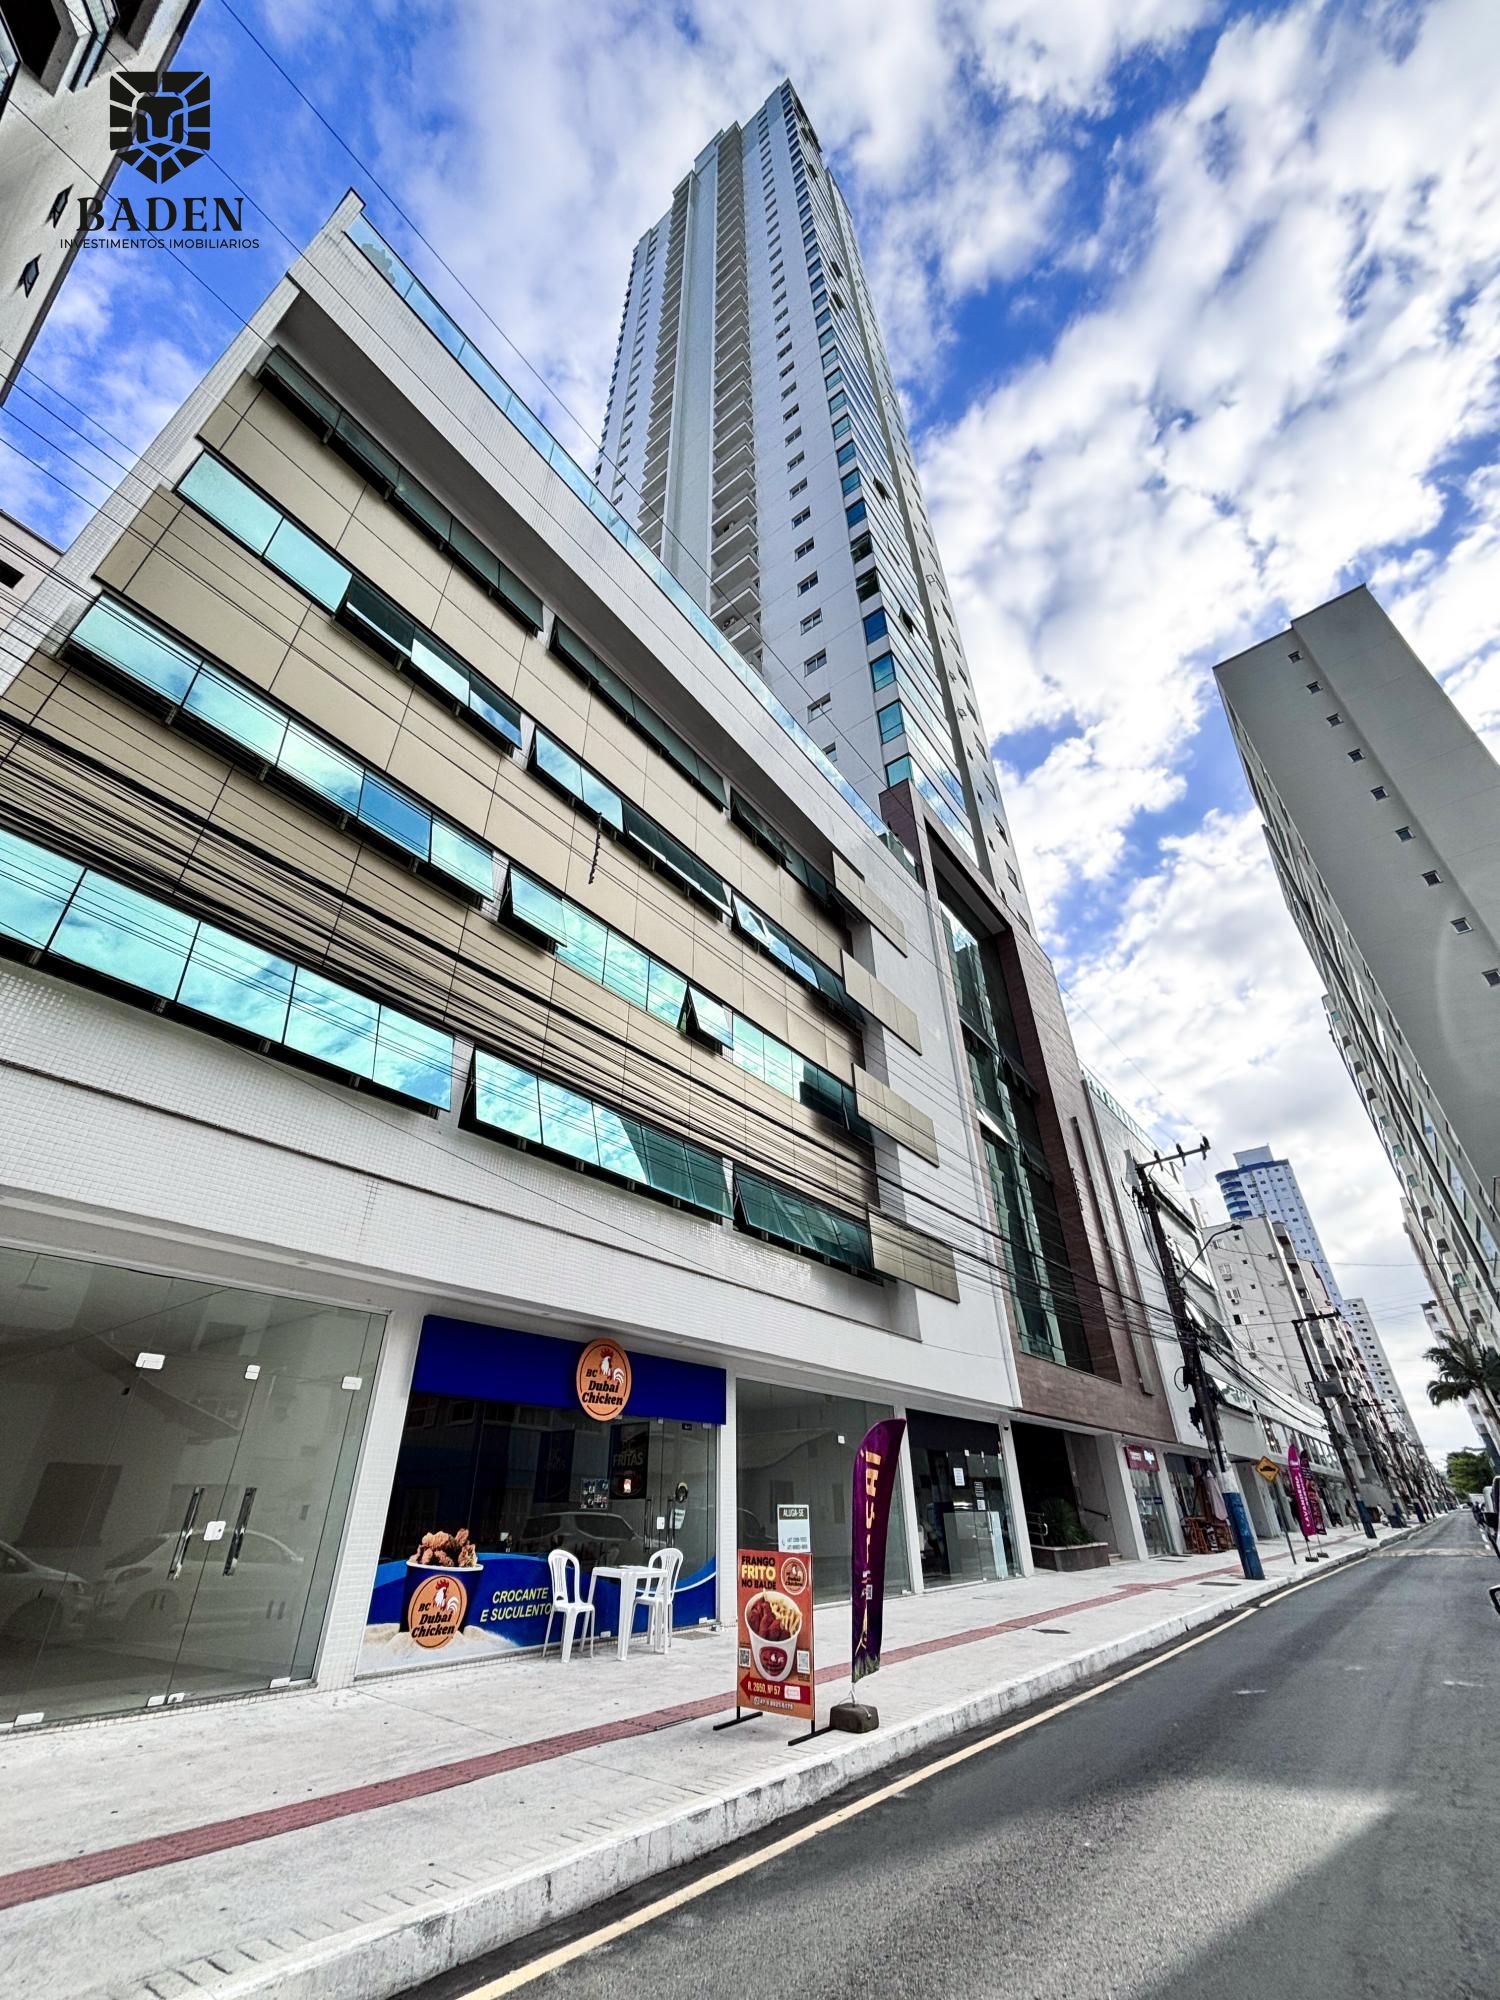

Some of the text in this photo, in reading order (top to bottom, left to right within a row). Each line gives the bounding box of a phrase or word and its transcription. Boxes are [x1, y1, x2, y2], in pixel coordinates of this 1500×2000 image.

[586, 1368, 598, 1378] BC
[588, 1380, 620, 1393] Dubai
[582, 1392, 623, 1406] Chicken
[741, 1555, 776, 1567] FRANGO
[741, 1564, 776, 1581] FRITO
[741, 1579, 776, 1590] NO BALDE
[492, 1587, 549, 1604] CROCANTE
[418, 1603, 431, 1612] BC
[480, 1603, 552, 1623] E SUCULENTO
[419, 1611, 453, 1625] Dubai
[411, 1624, 456, 1638] Chicken
